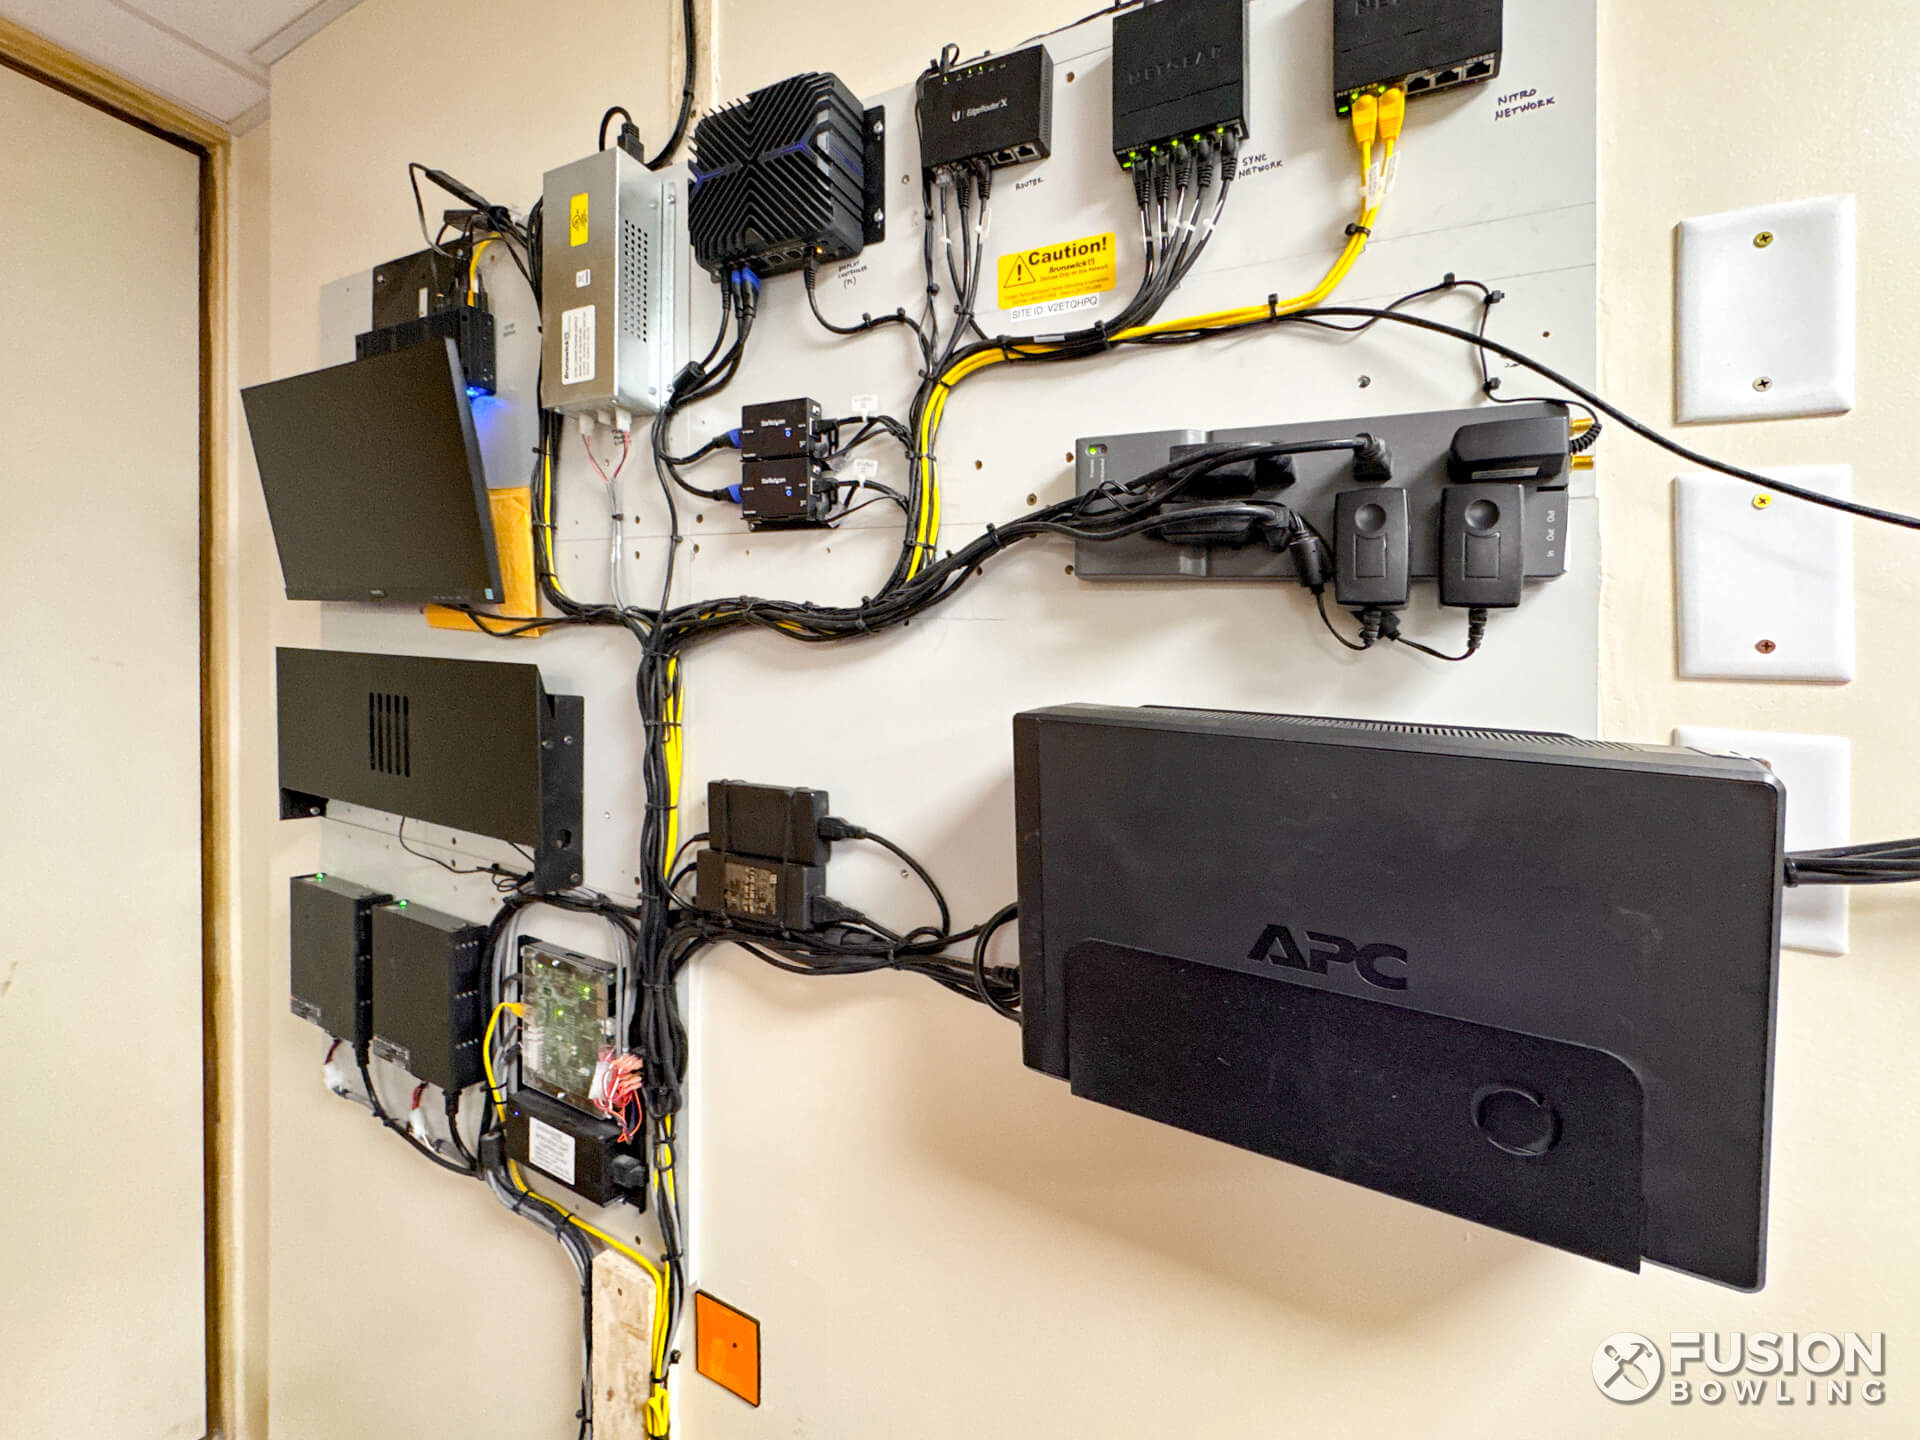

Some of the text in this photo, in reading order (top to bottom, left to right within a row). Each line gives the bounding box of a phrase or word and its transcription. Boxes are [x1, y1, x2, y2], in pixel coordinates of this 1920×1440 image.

[1497, 88, 1537, 106] NITRO
[1494, 96, 1556, 121] NETWORK
[1238, 159, 1284, 180] NETWORK
[1242, 153, 1267, 167] SYNC
[1028, 236, 1107, 266] Caution!
[1048, 260, 1087, 273] Brunswick
[1012, 308, 1033, 320] SITE
[1034, 305, 1044, 316] ID
[1246, 923, 1408, 990] APC
